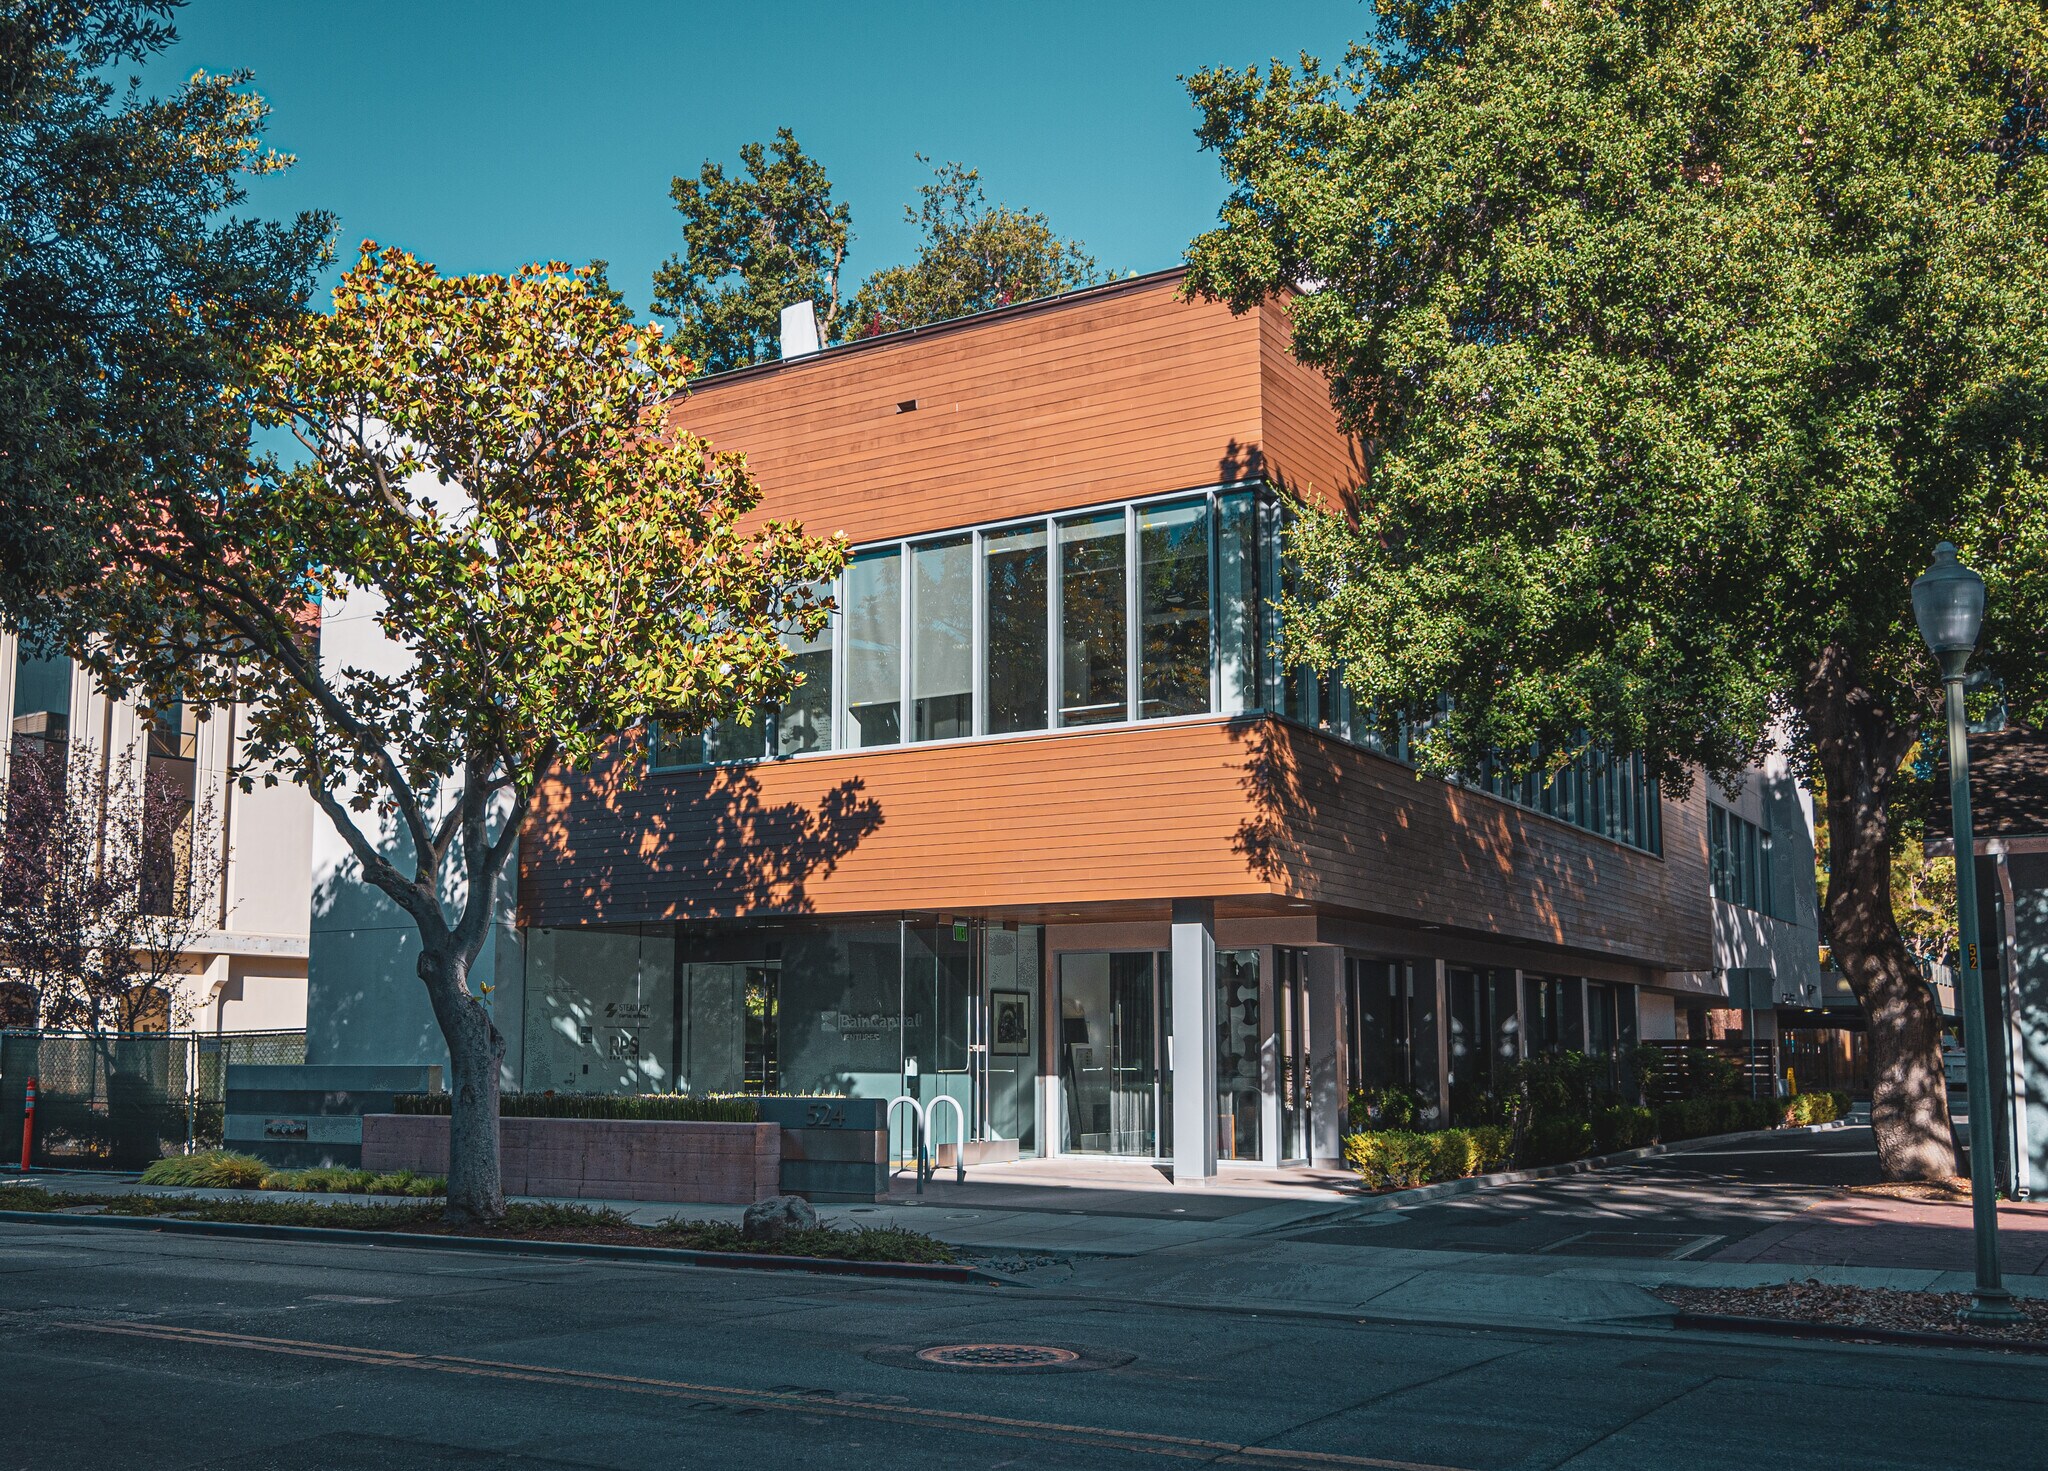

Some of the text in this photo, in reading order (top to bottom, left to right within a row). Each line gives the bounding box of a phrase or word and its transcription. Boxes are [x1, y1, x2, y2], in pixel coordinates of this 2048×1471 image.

[1969, 943, 1977, 969] 52
[610, 1036, 639, 1055] RPS
[807, 1103, 845, 1127] 524
